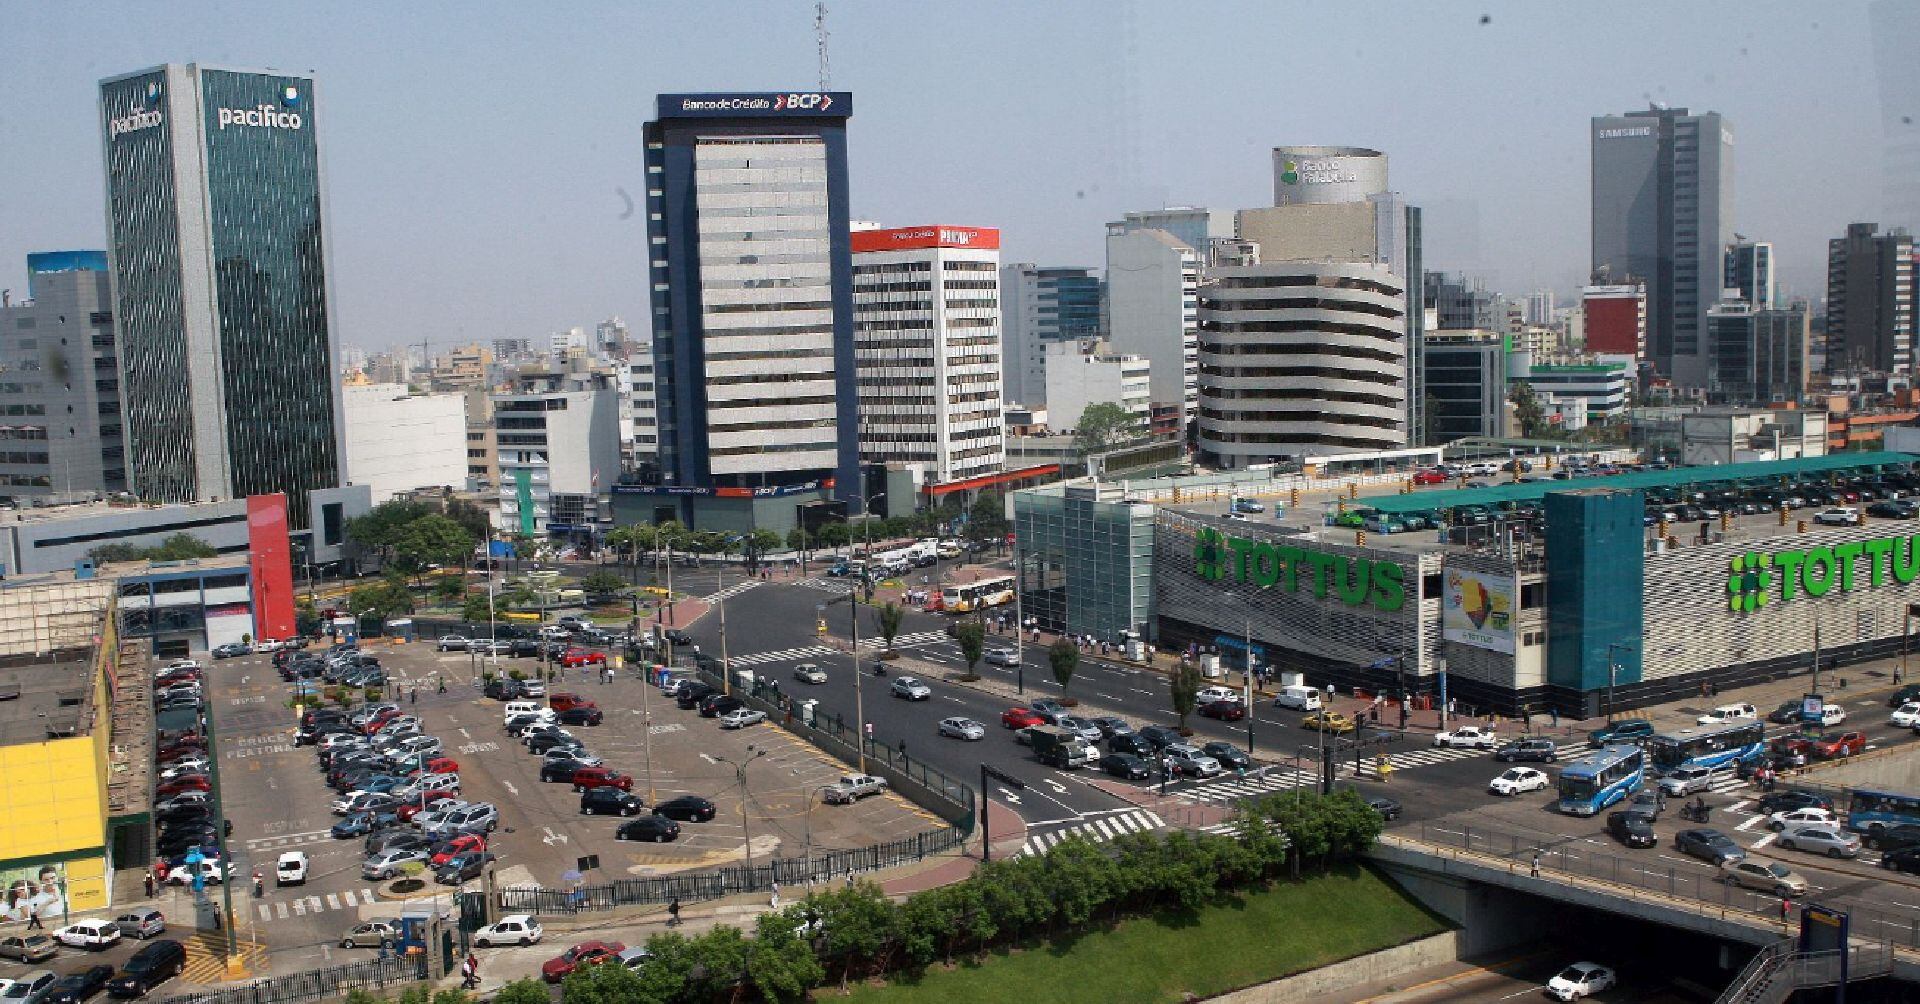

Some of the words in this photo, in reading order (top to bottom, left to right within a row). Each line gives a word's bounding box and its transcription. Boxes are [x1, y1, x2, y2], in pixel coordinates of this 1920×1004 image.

[786, 93, 822, 109] BCP
[217, 104, 301, 130] pacifico
[1599, 126, 1650, 139] SAMSUNG
[1302, 160, 1339, 171] Banco
[1227, 536, 1405, 613] TOTTUS
[238, 734, 288, 747] CRUCE
